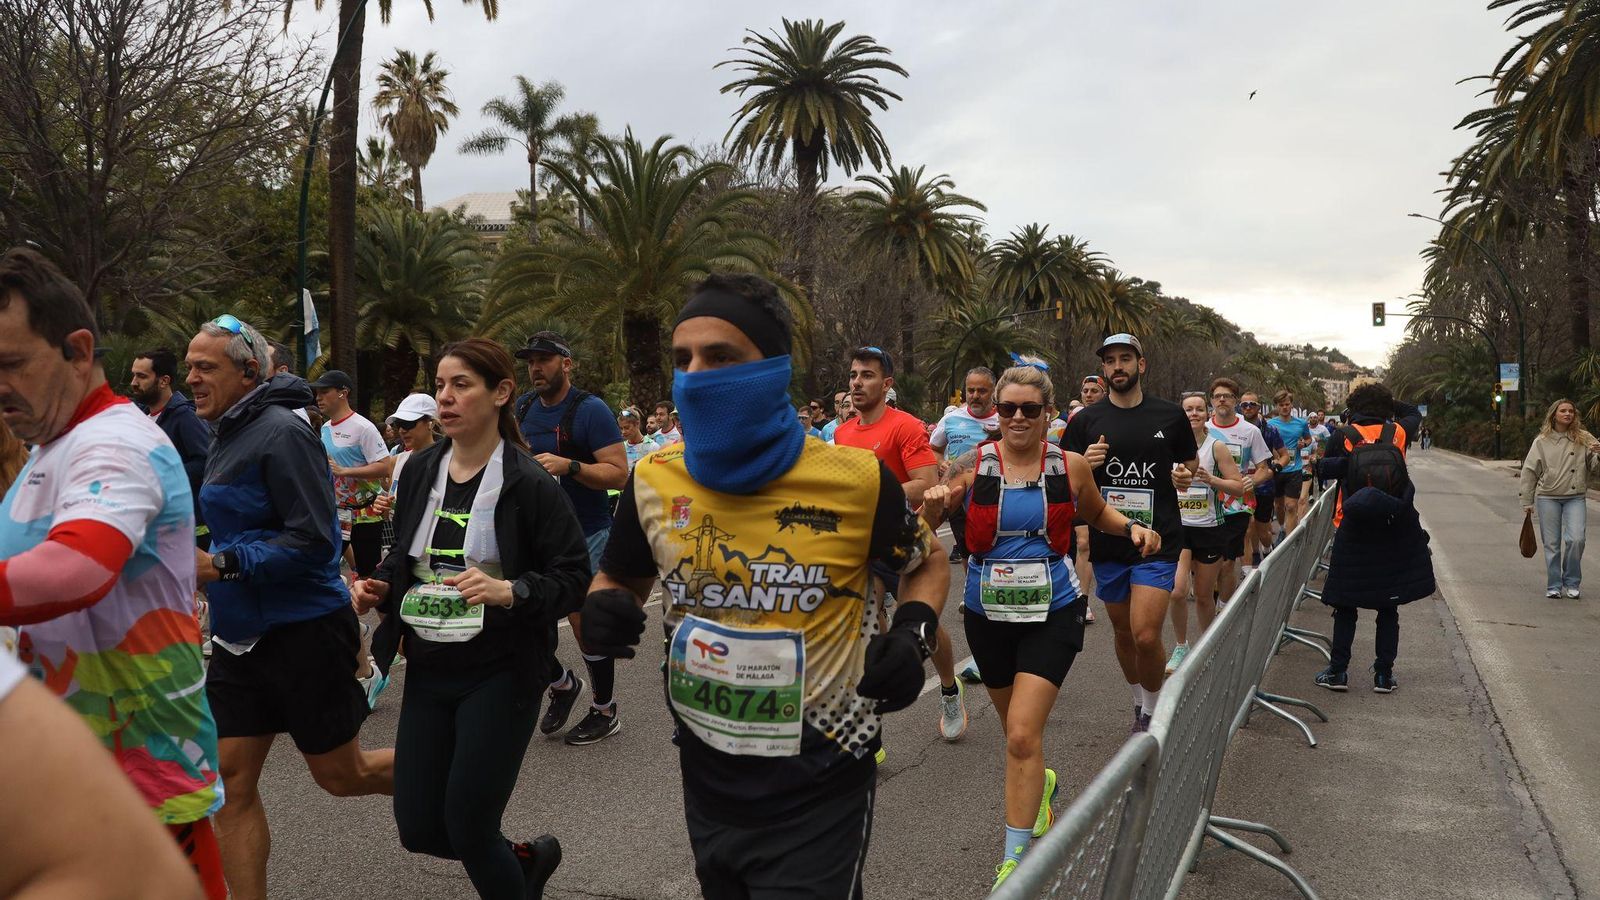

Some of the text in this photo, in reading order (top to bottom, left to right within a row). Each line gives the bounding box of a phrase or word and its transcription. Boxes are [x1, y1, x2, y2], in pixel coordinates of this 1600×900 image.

[1106, 456, 1157, 479] ÔAK
[1112, 478, 1149, 486] STUDIO
[1177, 500, 1202, 510] 3429
[749, 563, 829, 585] TRAIL
[667, 581, 825, 612] EL SANTO
[995, 589, 1040, 606] 6134
[417, 595, 469, 617] 5533
[691, 659, 729, 676] TotalEnergies
[736, 663, 781, 672] 1/2 MARATÓN
[746, 672, 775, 680] MÁLAGA
[694, 680, 779, 720] 4674
